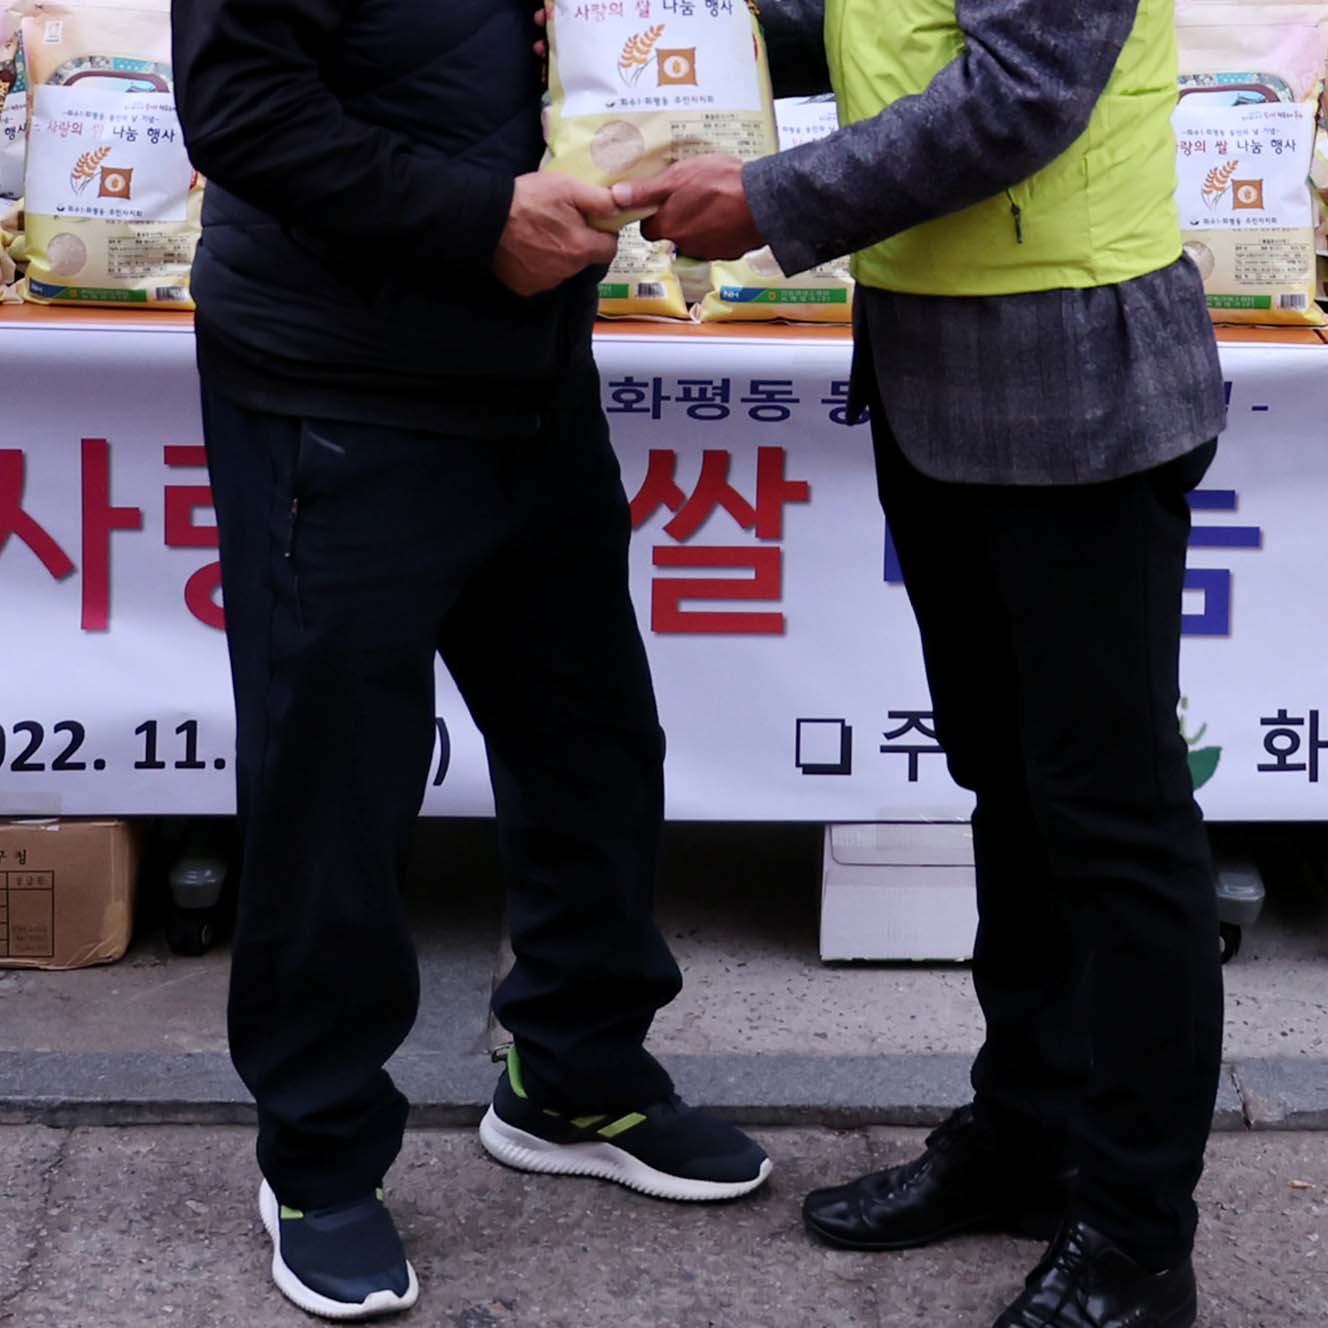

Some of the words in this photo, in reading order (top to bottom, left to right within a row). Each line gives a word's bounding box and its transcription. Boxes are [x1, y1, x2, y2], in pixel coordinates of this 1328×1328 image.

[575, 2, 623, 22] 사랑의
[113, 127, 139, 142] 나눔
[147, 128, 175, 144] 행사
[1177, 139, 1206, 156] 랑의
[1237, 139, 1263, 154] 나눔
[1270, 138, 1296, 155] 행사
[629, 446, 809, 635] 쌀
[133, 719, 226, 771] 11.
